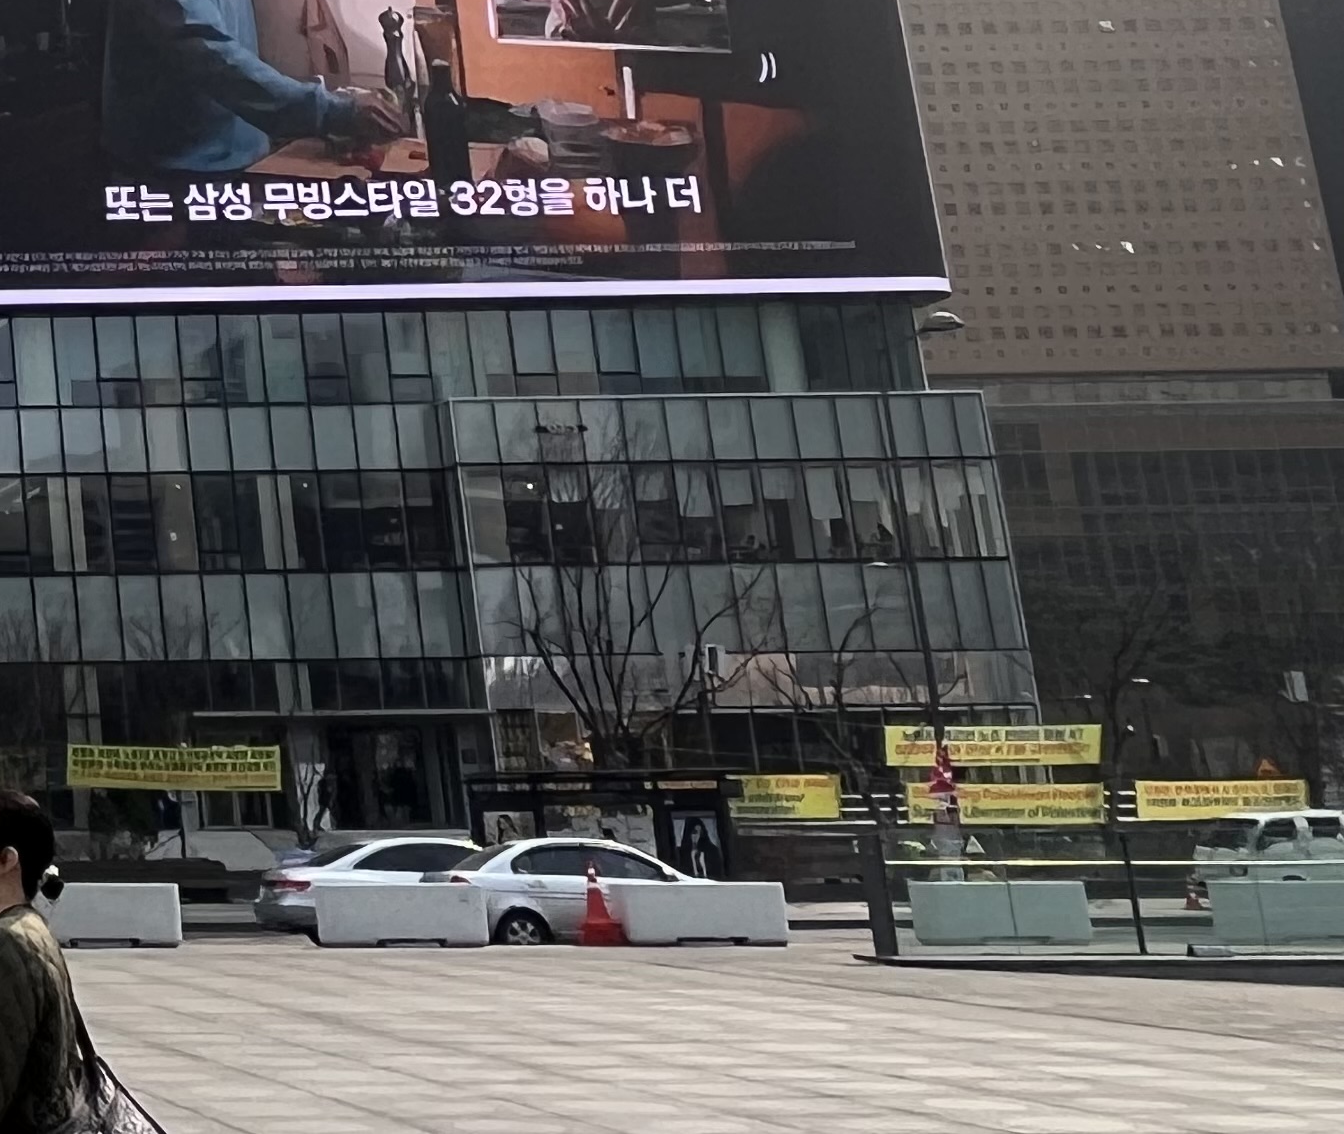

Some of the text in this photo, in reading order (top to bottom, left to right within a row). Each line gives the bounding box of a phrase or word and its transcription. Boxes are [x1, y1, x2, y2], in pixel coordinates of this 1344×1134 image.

[105, 175, 702, 222] 또는 삼성 무빙스타일 32형을 하나 더
